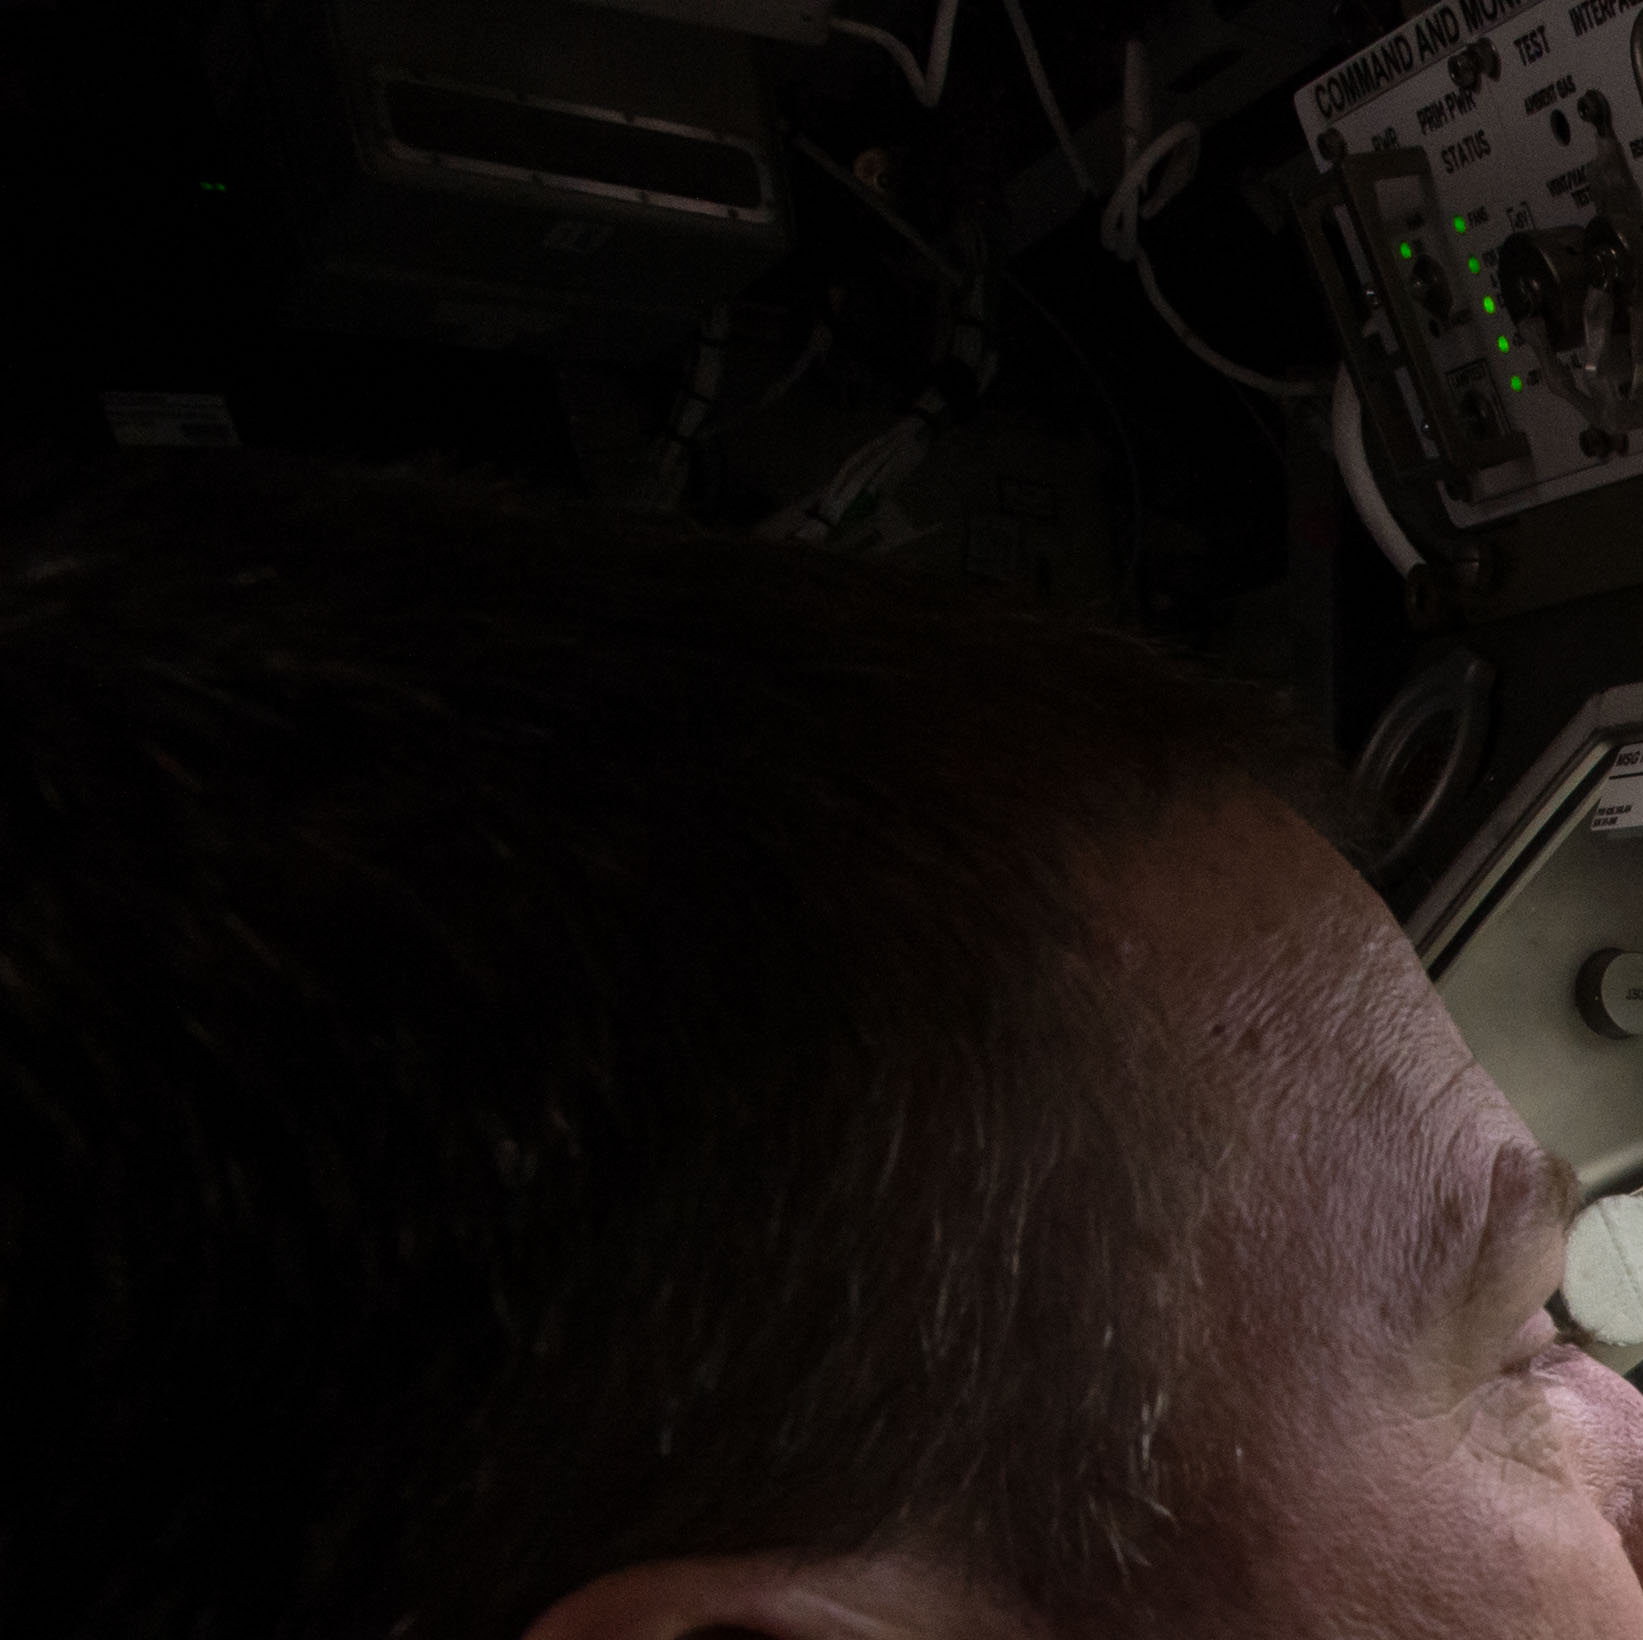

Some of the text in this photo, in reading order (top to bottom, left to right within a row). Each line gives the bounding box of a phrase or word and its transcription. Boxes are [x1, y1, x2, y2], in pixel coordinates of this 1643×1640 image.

[1314, 36, 1415, 118] COMMAND
[1414, 7, 1461, 63] AND
[1513, 24, 1551, 67] TEST
[1441, 129, 1492, 174] STATUS
